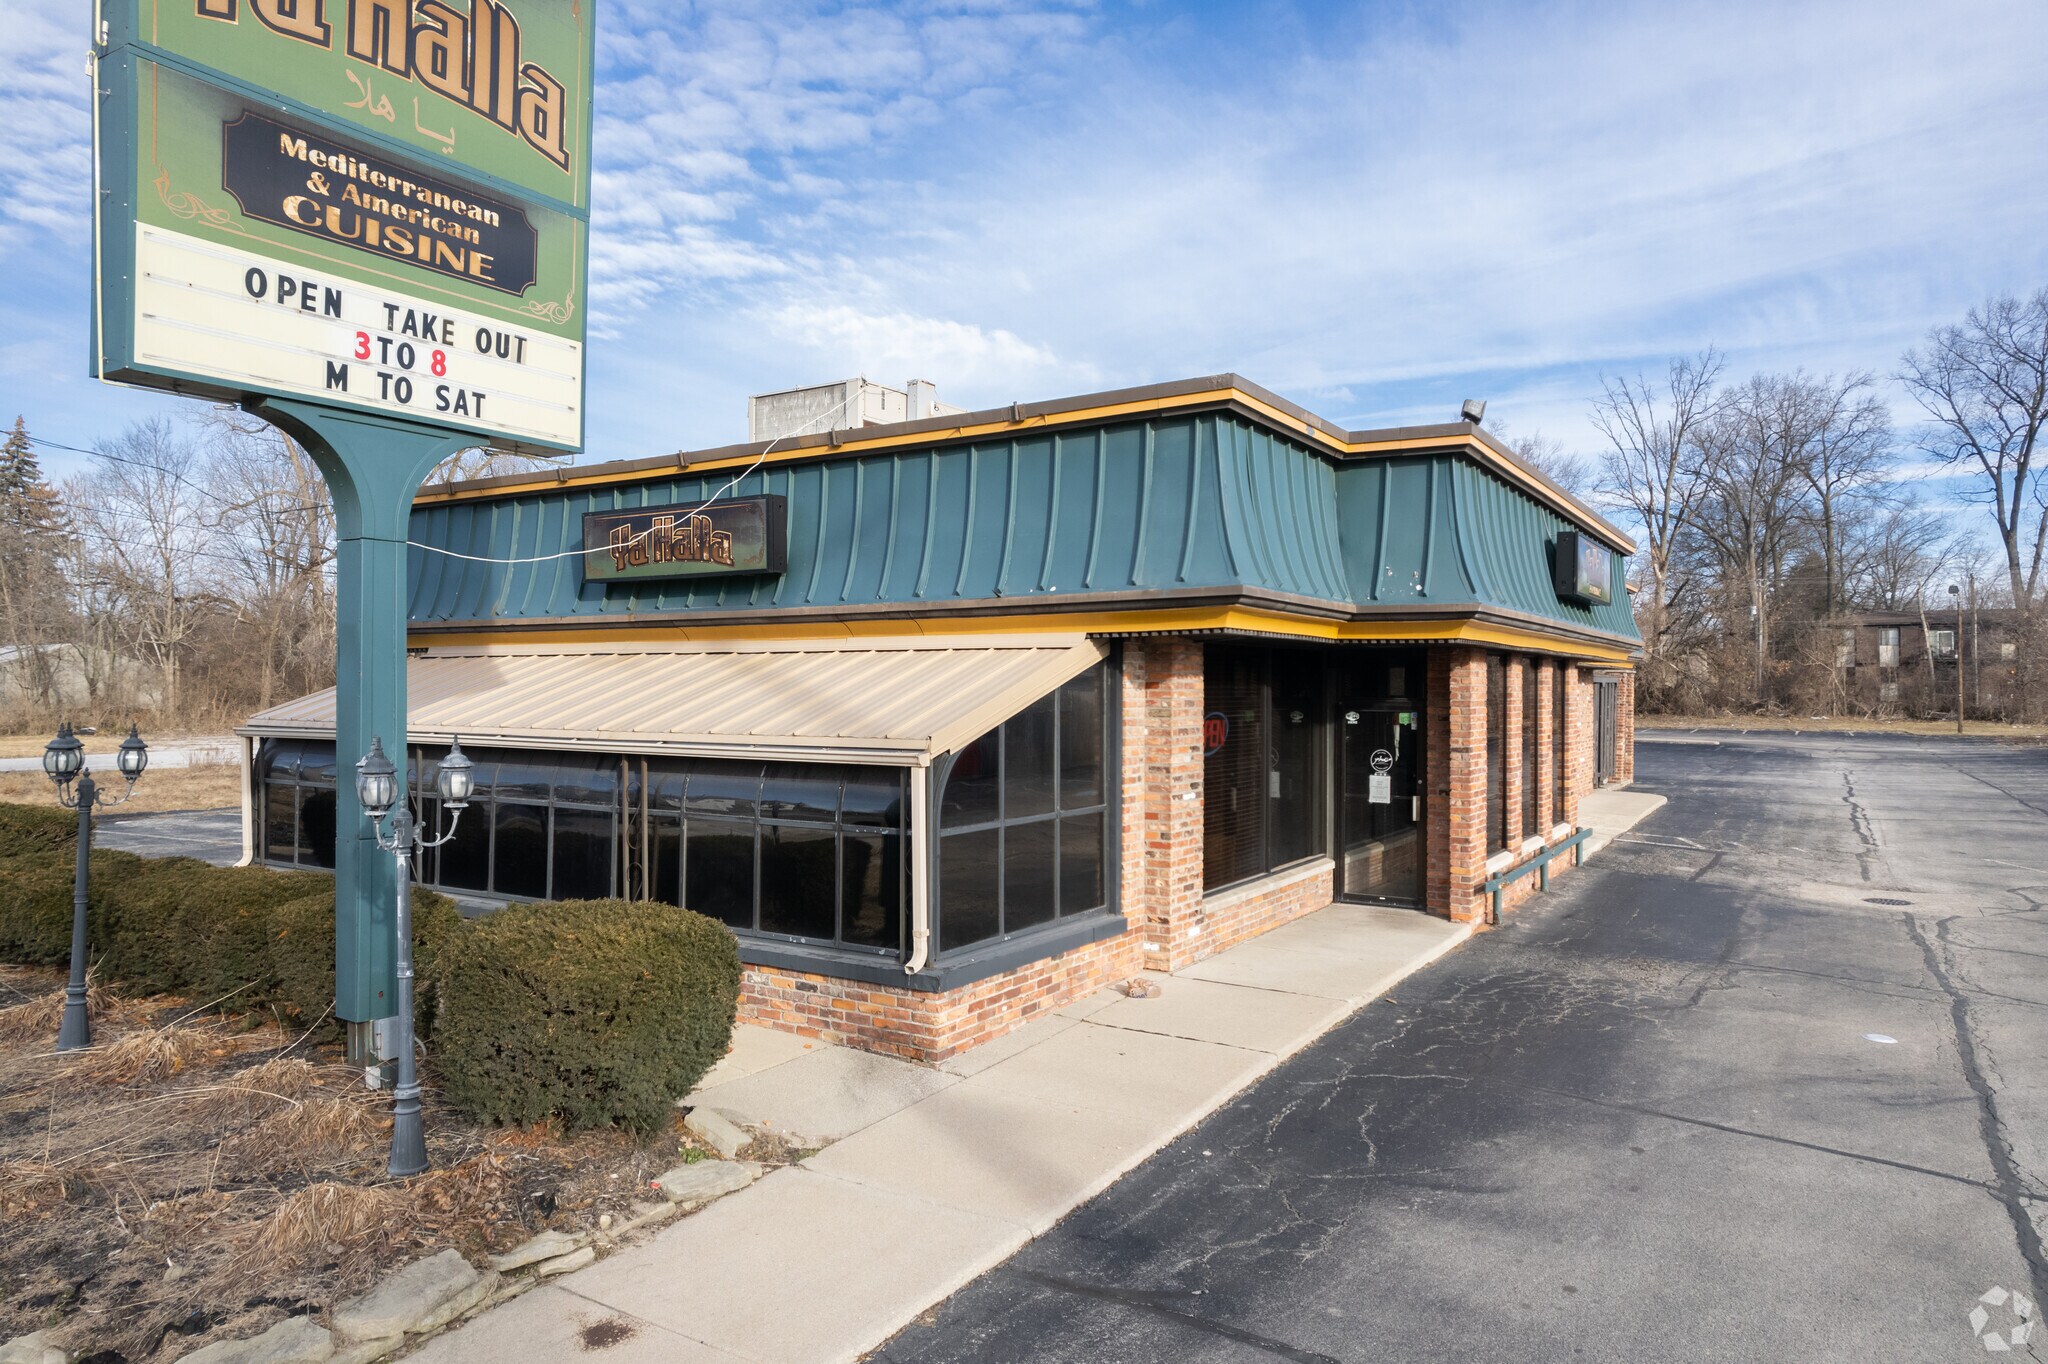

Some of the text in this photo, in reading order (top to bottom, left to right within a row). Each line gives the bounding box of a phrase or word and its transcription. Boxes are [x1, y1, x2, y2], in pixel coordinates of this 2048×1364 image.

[280, 133, 500, 228] Mediterranean
[306, 171, 480, 245] & American
[282, 195, 496, 282] CUISINE
[244, 267, 528, 364] OPEN TAKE OUT
[326, 360, 486, 418] M TO SAT
[431, 349, 447, 377] 8
